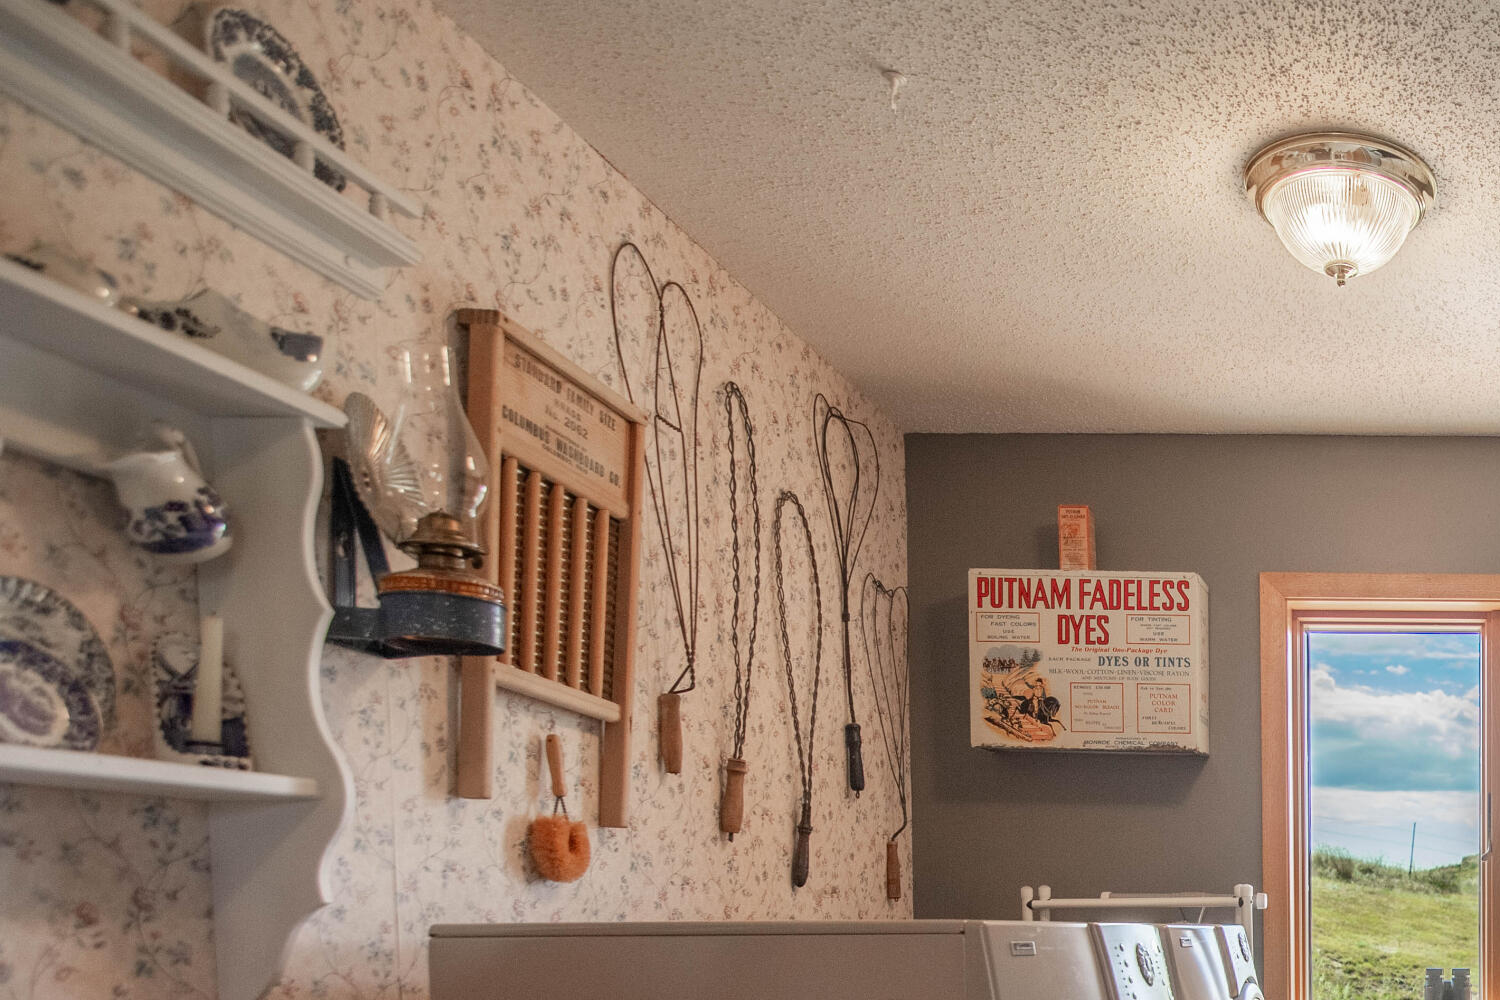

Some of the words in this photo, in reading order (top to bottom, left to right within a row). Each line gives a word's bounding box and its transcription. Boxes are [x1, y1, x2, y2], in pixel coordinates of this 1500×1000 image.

[502, 404, 550, 444] COLUMBUS
[976, 577, 1072, 610] PUTNAM
[1078, 579, 1190, 611] FADELESS
[1057, 614, 1109, 646] DYES
[1098, 655, 1129, 666] DYES
[1134, 656, 1150, 667] OR
[1155, 656, 1191, 668] TINTS
